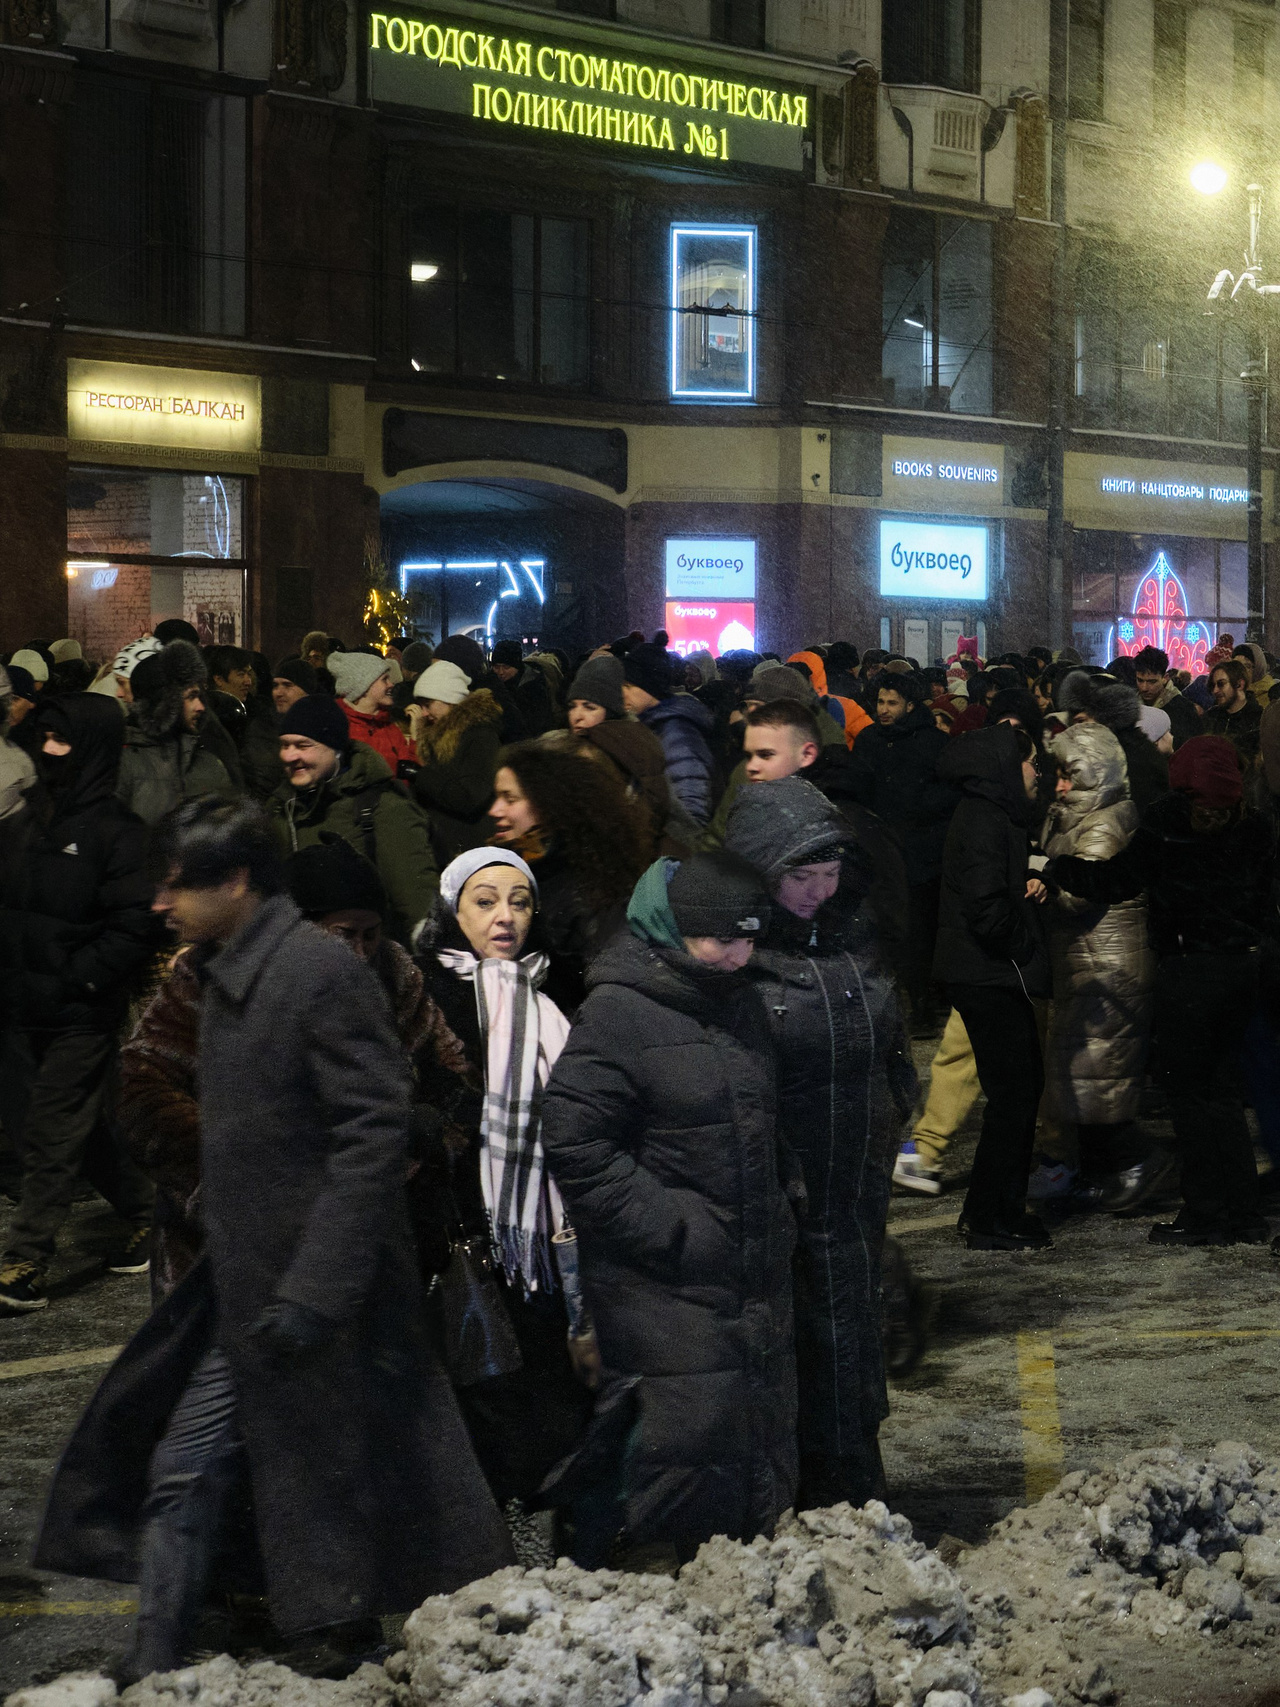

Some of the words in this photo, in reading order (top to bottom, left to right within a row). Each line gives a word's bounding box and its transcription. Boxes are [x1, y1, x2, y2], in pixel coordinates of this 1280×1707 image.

[371, 13, 532, 77] ГОРОДСКАЯ
[537, 46, 808, 128] СТОМАТОЛОГИЧЕСКАЯ
[472, 83, 675, 151] ПОЛИКЛИНИКА
[684, 121, 730, 161] №1
[89, 392, 163, 412] РЕСТОРАН
[172, 397, 245, 421] БАЛКАН
[895, 461, 933, 477] BOOKS
[938, 464, 998, 482] SOUVENIRS
[1102, 478, 1136, 493] КНИГИ
[1141, 481, 1204, 499] КАНЦТОВАРЫ
[677, 553, 744, 574] буквоед
[891, 542, 972, 579] буквоед
